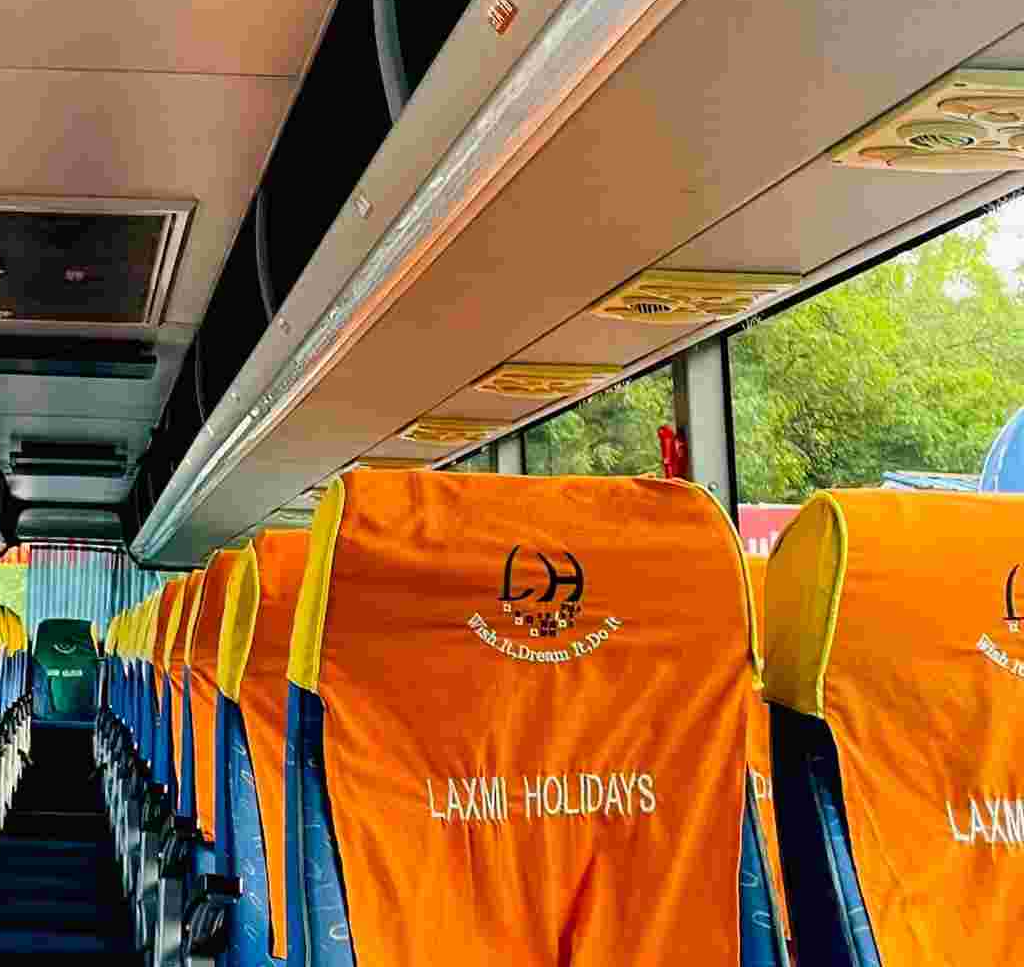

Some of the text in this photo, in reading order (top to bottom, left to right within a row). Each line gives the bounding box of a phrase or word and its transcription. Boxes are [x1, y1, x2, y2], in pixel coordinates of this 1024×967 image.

[467, 612, 497, 646] Wish
[426, 772, 657, 824] LAXMI HOLIDAYS
[945, 799, 1024, 844] LAXM
